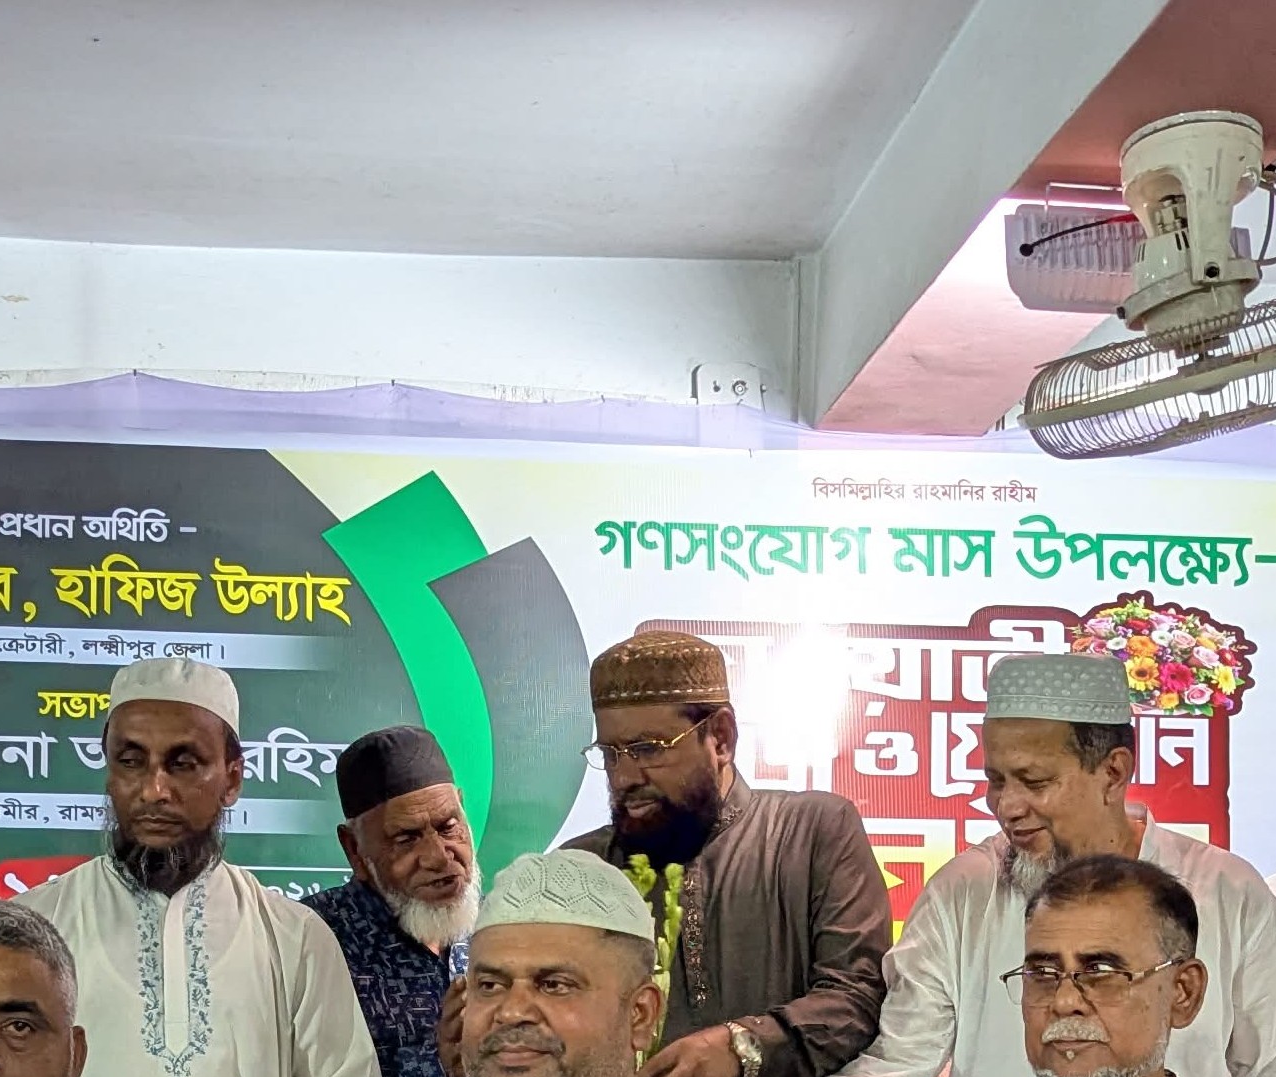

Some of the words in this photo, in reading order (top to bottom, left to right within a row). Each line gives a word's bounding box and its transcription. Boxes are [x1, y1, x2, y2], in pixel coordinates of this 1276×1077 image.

[913, 479, 986, 501] রাহমানির
[991, 480, 1038, 503] রাহীম
[594, 520, 871, 582] গণসংযোগ
[888, 527, 996, 578] মাস
[50, 553, 201, 618] হাফিজ
[209, 557, 352, 626] উল্যাহ
